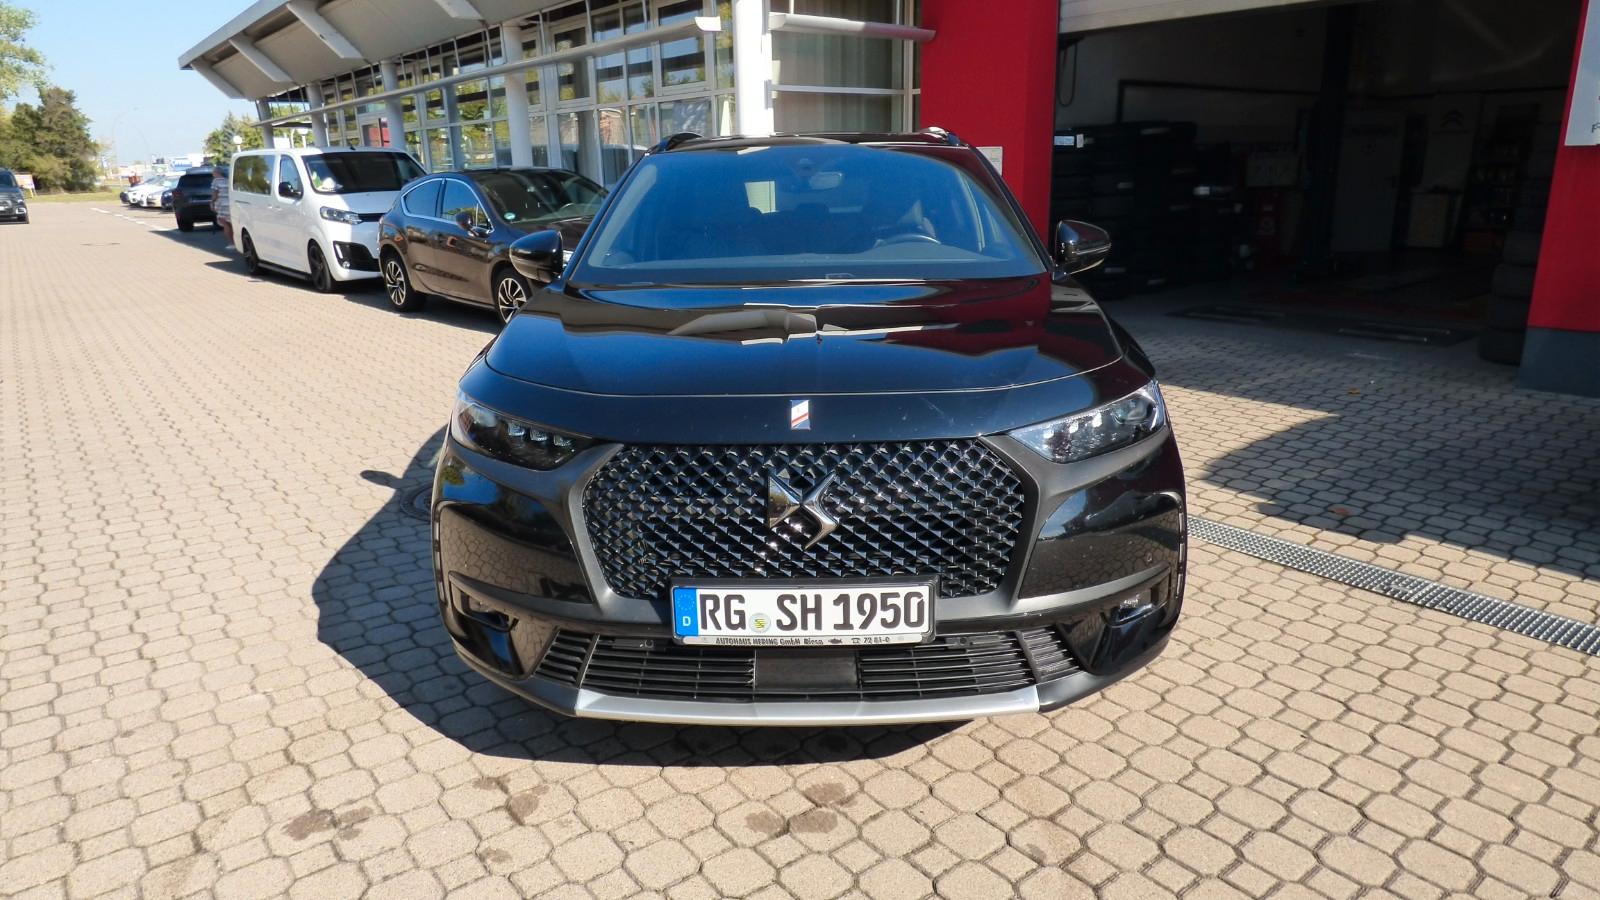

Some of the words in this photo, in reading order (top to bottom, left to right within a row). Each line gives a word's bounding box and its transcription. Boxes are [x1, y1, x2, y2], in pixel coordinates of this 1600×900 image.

[700, 593, 747, 631] RG
[776, 593, 823, 631] SH
[833, 591, 926, 631] 1950
[682, 616, 692, 627] D
[715, 637, 752, 646] AUTOHAUS
[779, 637, 801, 646] GmbH
